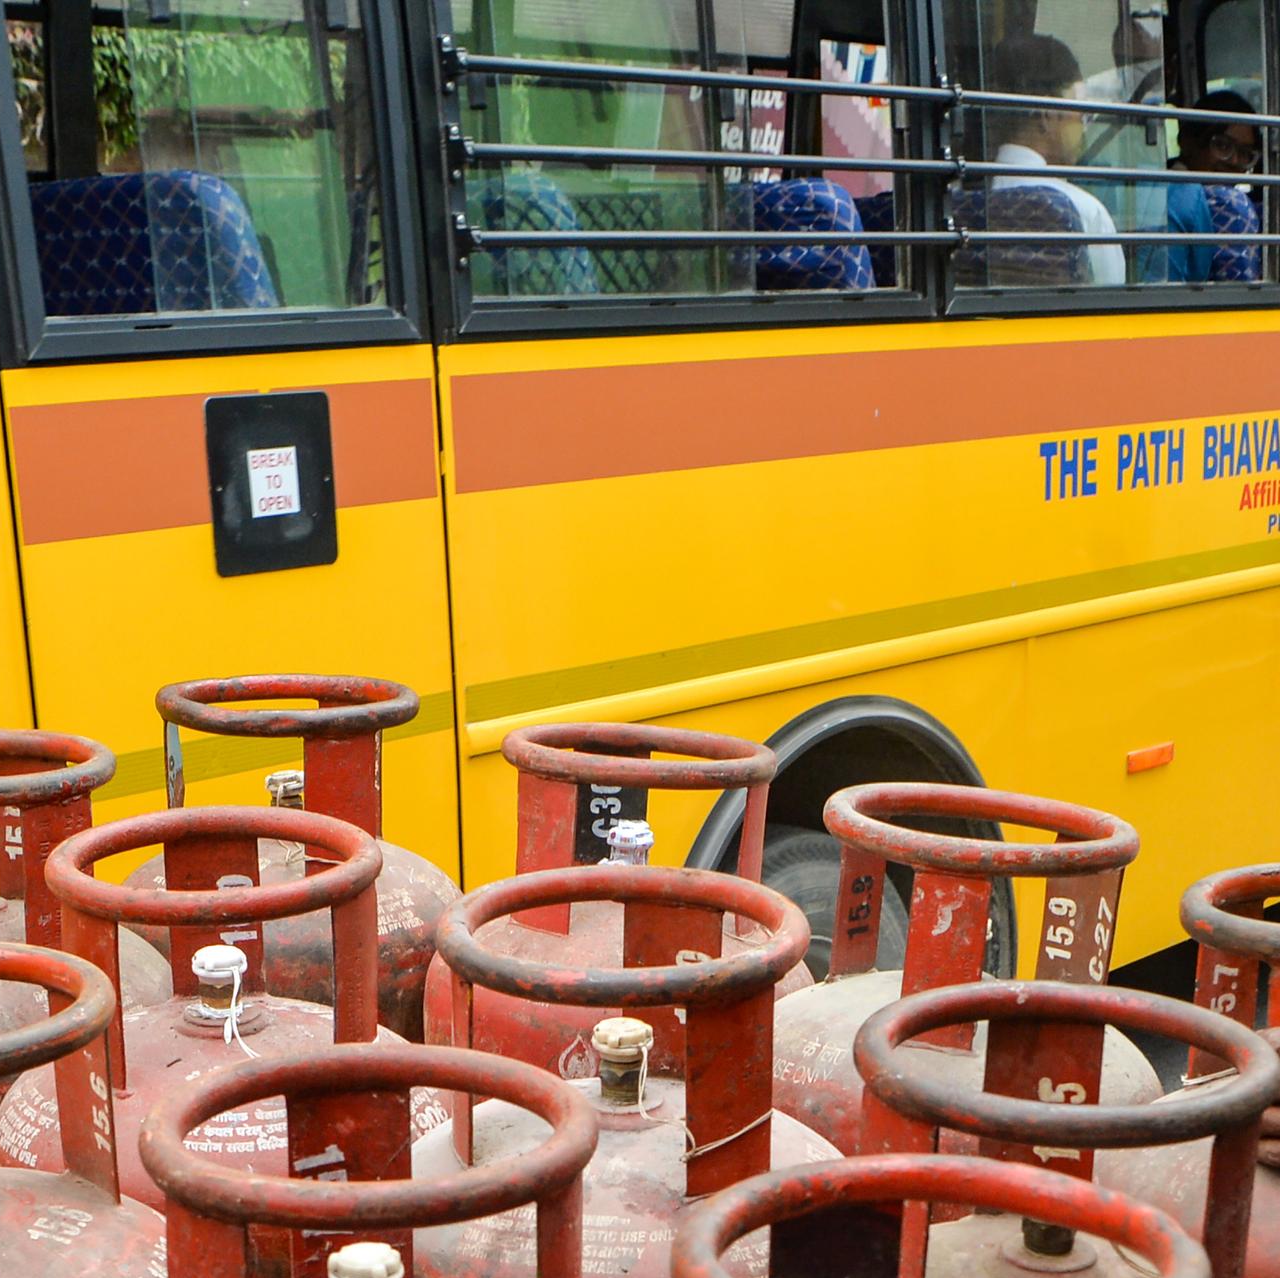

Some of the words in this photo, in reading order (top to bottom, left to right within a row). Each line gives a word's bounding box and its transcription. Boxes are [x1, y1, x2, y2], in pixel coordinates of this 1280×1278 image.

[250, 451, 294, 470] BREAK
[1039, 436, 1098, 501] THE
[1116, 428, 1185, 492] PATH
[265, 474, 283, 490] TO
[258, 495, 293, 512] OPEN
[1044, 896, 1079, 961] 15.9
[1088, 896, 1114, 983] C-27
[1210, 963, 1239, 1014] 5.7
[620, 1230, 646, 1244] USE
